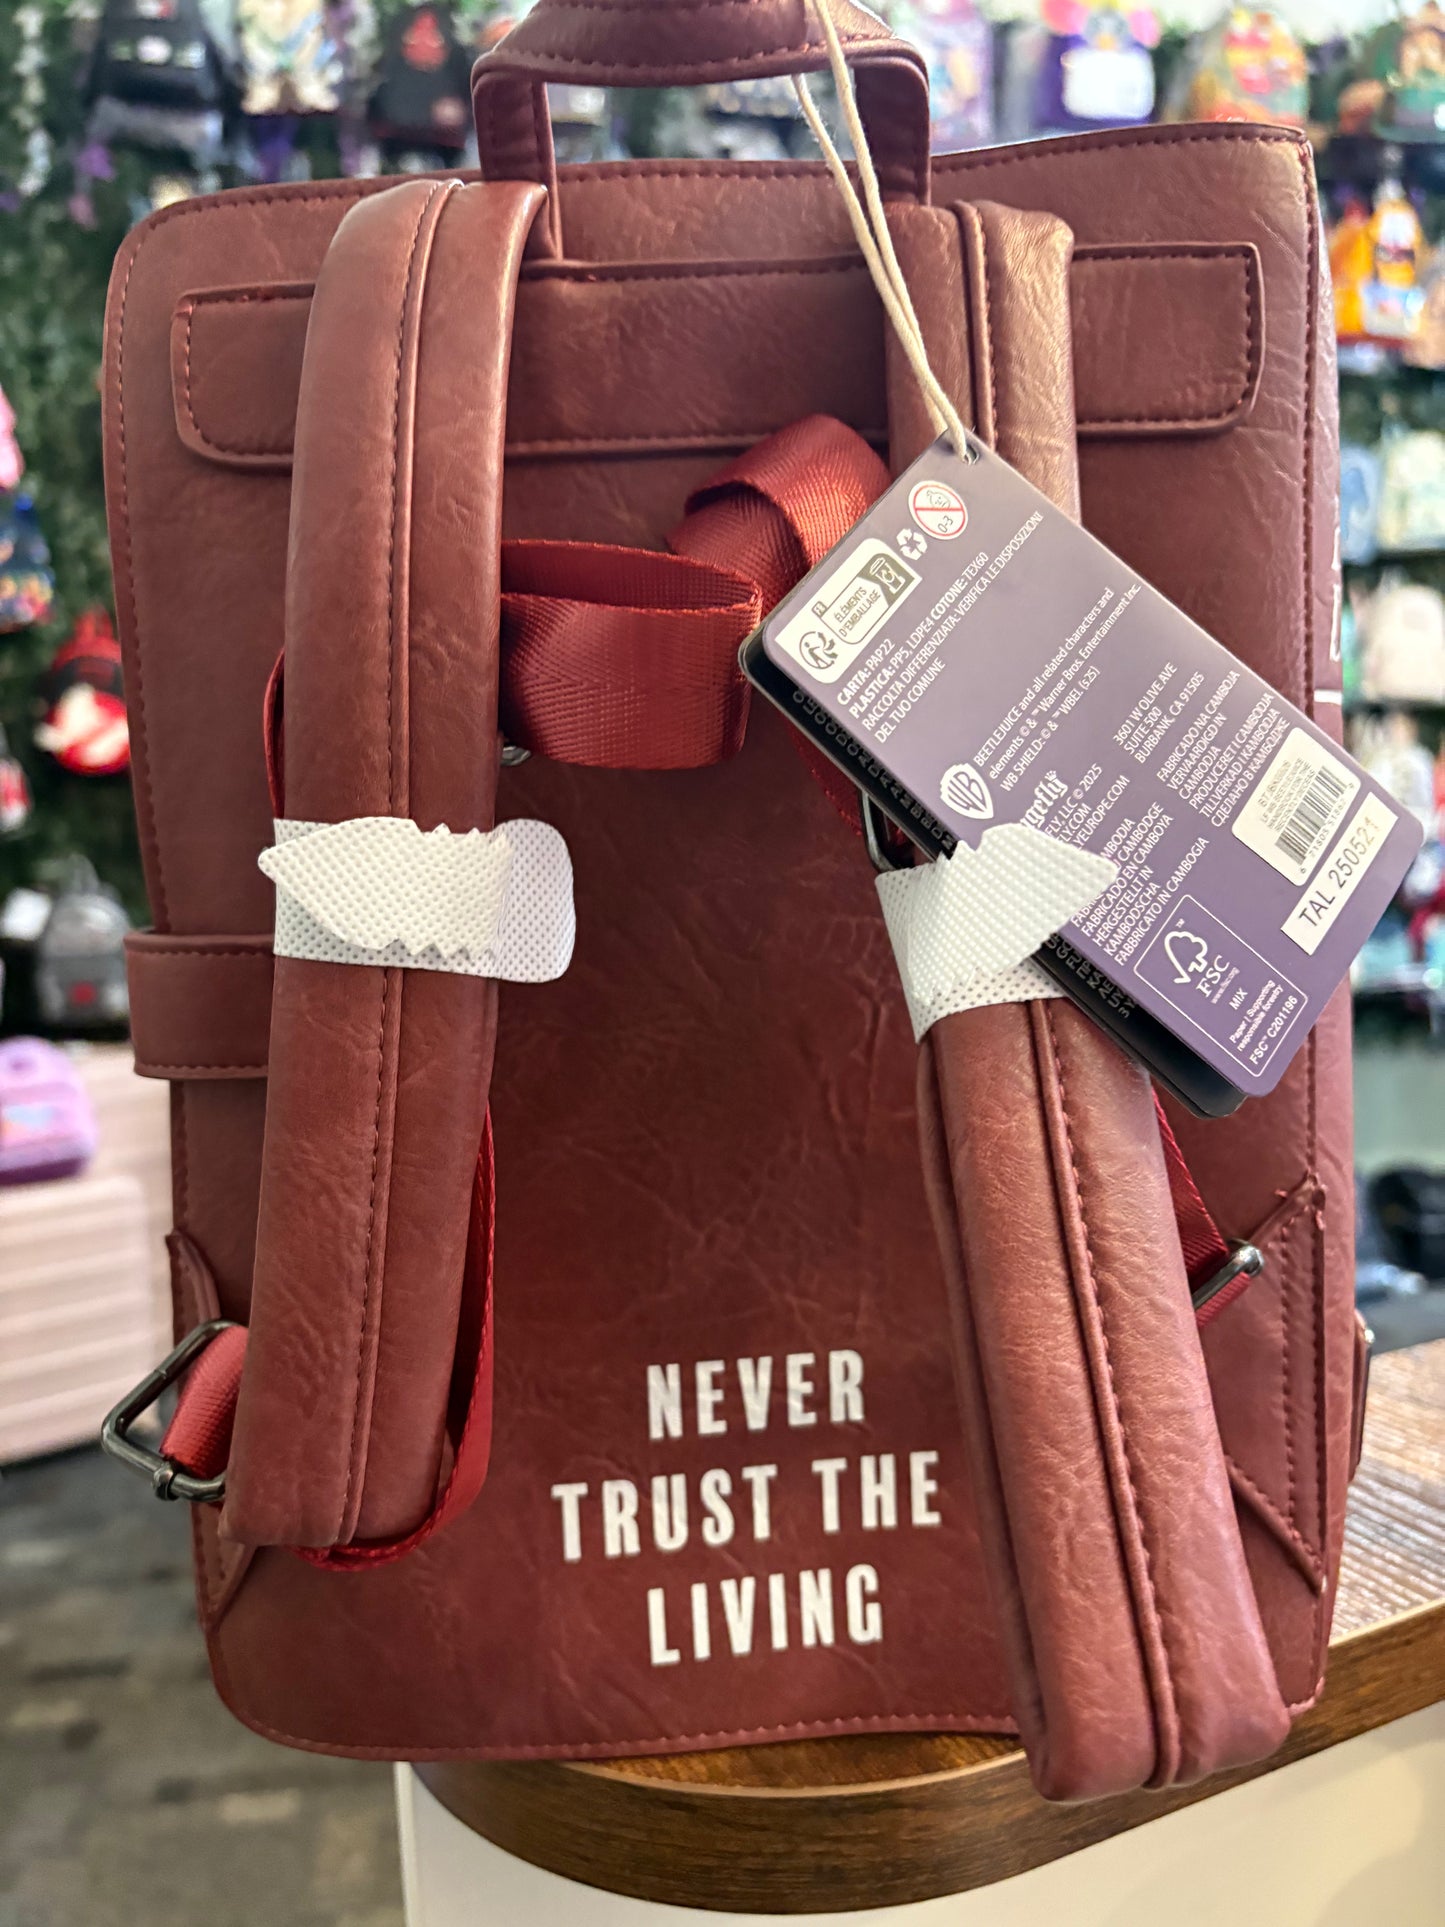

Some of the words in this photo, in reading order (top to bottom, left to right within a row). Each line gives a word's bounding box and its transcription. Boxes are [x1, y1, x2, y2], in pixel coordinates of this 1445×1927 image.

[937, 515, 953, 533] 0-3
[834, 586, 866, 623] ÉLÉMENTS
[848, 665, 895, 718] PLASTICA:
[889, 646, 912, 668] PP5,
[905, 616, 934, 649] LDPE4
[930, 578, 967, 620] COTONE:
[961, 551, 988, 580] TEX60
[861, 680, 905, 730] RACCOLTA
[899, 613, 960, 683] DIFFERENZIATA:
[954, 576, 991, 615] VERIFICA
[984, 563, 1000, 579] LE
[993, 510, 1043, 568] DISPOSIZIONI
[836, 667, 871, 704] CARTA:
[865, 638, 895, 670] PAP22
[874, 721, 896, 743] DEL
[888, 699, 911, 722] TUO
[907, 657, 945, 702] COMUNE
[973, 705, 1022, 766] BEETLEJUICE
[1018, 687, 1035, 710] and
[1032, 676, 1044, 692] all
[1041, 646, 1068, 680] related
[1064, 605, 1101, 650] characters
[1097, 586, 1114, 608] and
[989, 735, 1024, 779] elements
[1025, 718, 1037, 728] &
[1037, 678, 1066, 711] Warner
[1061, 659, 1084, 680] Bros.
[1078, 597, 1129, 659] Entertainment
[1112, 719, 1134, 745] 3601
[1129, 706, 1142, 720] W
[1138, 680, 1164, 710] OLIVE
[1158, 662, 1177, 684] AVE
[999, 771, 1018, 791] WB
[1012, 737, 1045, 775] SHIELD:
[1046, 720, 1058, 731] &
[1078, 665, 1100, 690] (s25)
[1123, 723, 1149, 754] SUITE
[1143, 706, 1162, 727] 500
[1134, 714, 1175, 763] BURBANK,
[1169, 700, 1185, 715] CA
[1179, 671, 1204, 702] 91505
[1156, 726, 1199, 781] FABRICADO
[1193, 712, 1210, 729] NA
[1204, 670, 1240, 714] CAMBOJA
[1166, 723, 1218, 789] VERVAARDIGD
[1212, 712, 1226, 726] IN
[1188, 744, 1236, 809] PRODUCERET
[1234, 692, 1274, 743] CAMBODJA
[1058, 796, 1078, 818] LLC
[1078, 763, 1102, 791] 2025
[1178, 745, 1221, 799] CAMBODJA
[1198, 761, 1242, 817] TILLVERKAD
[1240, 708, 1280, 759] KAMBODJA
[1211, 777, 1248, 826] СДЕЛАНО
[1242, 769, 1254, 780] В
[1248, 716, 1290, 773] КАМБОДЖЕ
[1100, 815, 1136, 861] MBODIA
[1117, 801, 1163, 861] CAMBODGE
[1298, 890, 1335, 926] TAL
[1327, 817, 1378, 888] 250521
[1080, 876, 1127, 936] FABRICADO
[1121, 861, 1138, 879] EN
[1133, 814, 1173, 863] CAMBOYA
[1092, 876, 1144, 946] HERGESTELLT
[1138, 865, 1153, 880] IN
[1114, 902, 1162, 965] FABBRICATO
[1156, 889, 1171, 904] IN
[1166, 837, 1209, 891] CAMBOGIA
[1103, 882, 1160, 956] KAMBODSCHA
[1195, 954, 1229, 997] FSC
[1229, 987, 1247, 1009] MIX
[1229, 1020, 1248, 1044] Paper
[1246, 979, 1276, 1018] Supporting
[1266, 995, 1297, 1037] C201196
[1236, 1010, 1267, 1054] responsible
[646, 1349, 865, 1441] NEVER
[550, 1464, 778, 1562] TRUST
[811, 1450, 941, 1533] THE
[647, 1564, 883, 1666] LIVING
